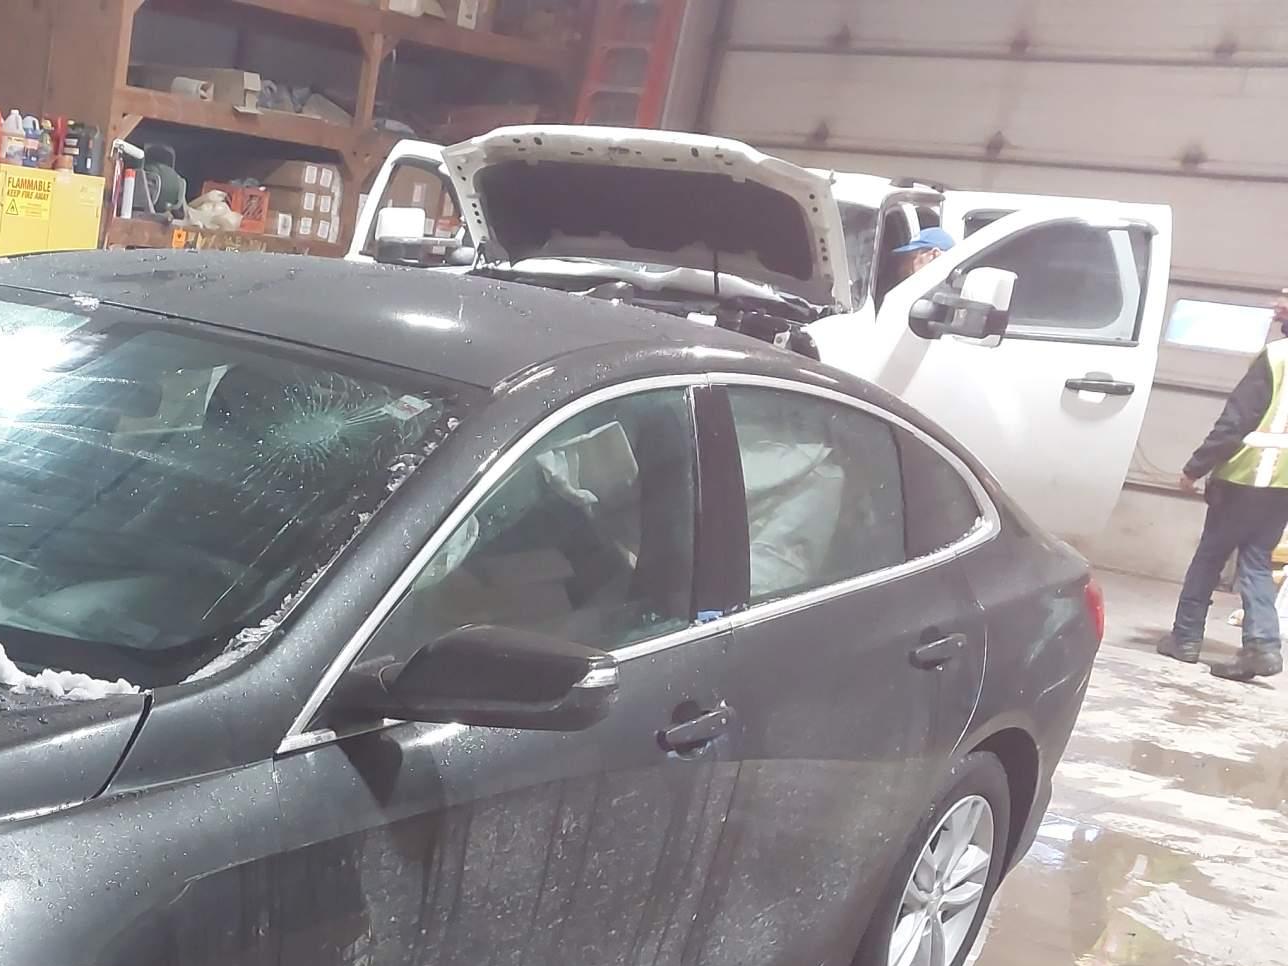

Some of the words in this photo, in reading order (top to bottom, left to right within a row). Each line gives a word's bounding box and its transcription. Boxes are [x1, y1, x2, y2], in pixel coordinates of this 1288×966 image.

[8, 177, 51, 192] FLAMMABLE
[7, 189, 21, 197] KEEP
[21, 190, 33, 199] FIRE
[34, 192, 49, 200] AWAY
